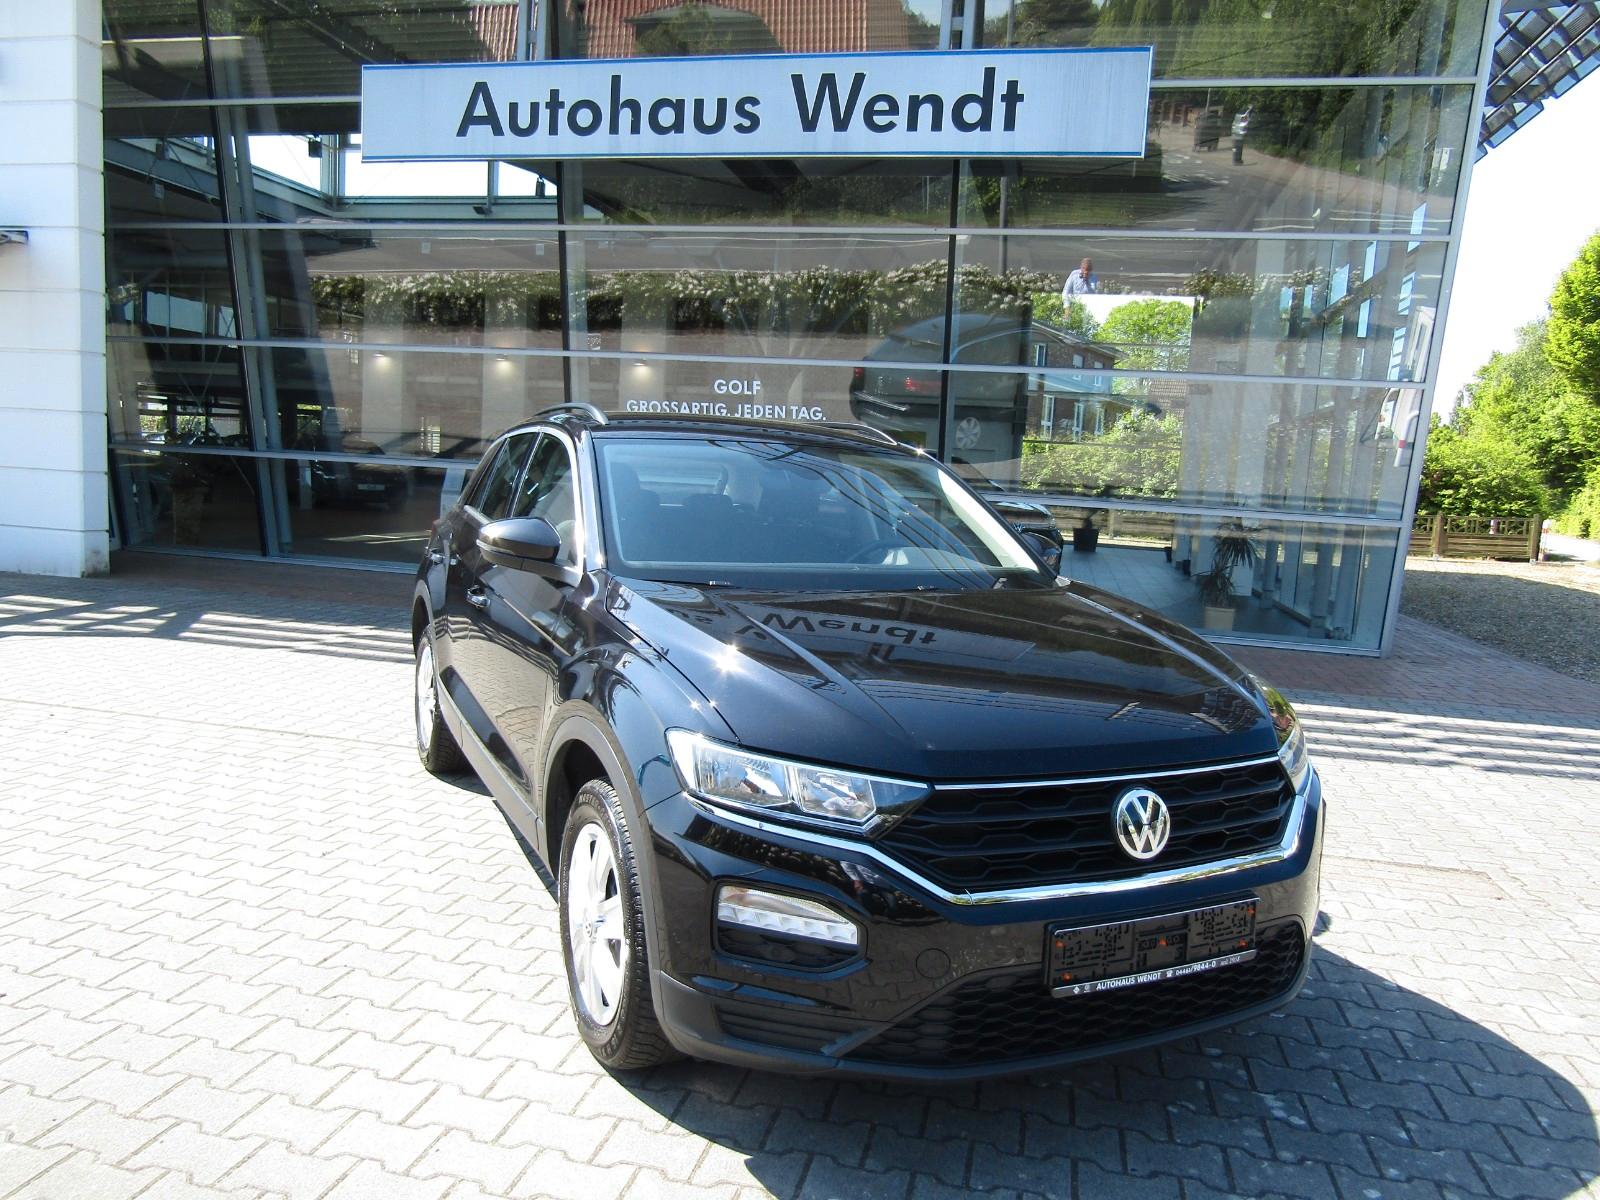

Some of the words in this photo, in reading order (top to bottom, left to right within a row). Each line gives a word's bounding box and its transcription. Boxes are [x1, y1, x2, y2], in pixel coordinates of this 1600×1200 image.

[457, 75, 760, 137] Autohaus
[791, 67, 1024, 133] Wendt
[714, 379, 761, 395] GOLF
[735, 404, 786, 419] JEDEN
[790, 406, 827, 420] TAG.
[1096, 978, 1135, 991] AUTOHAUS
[1137, 973, 1161, 983] WENDT
